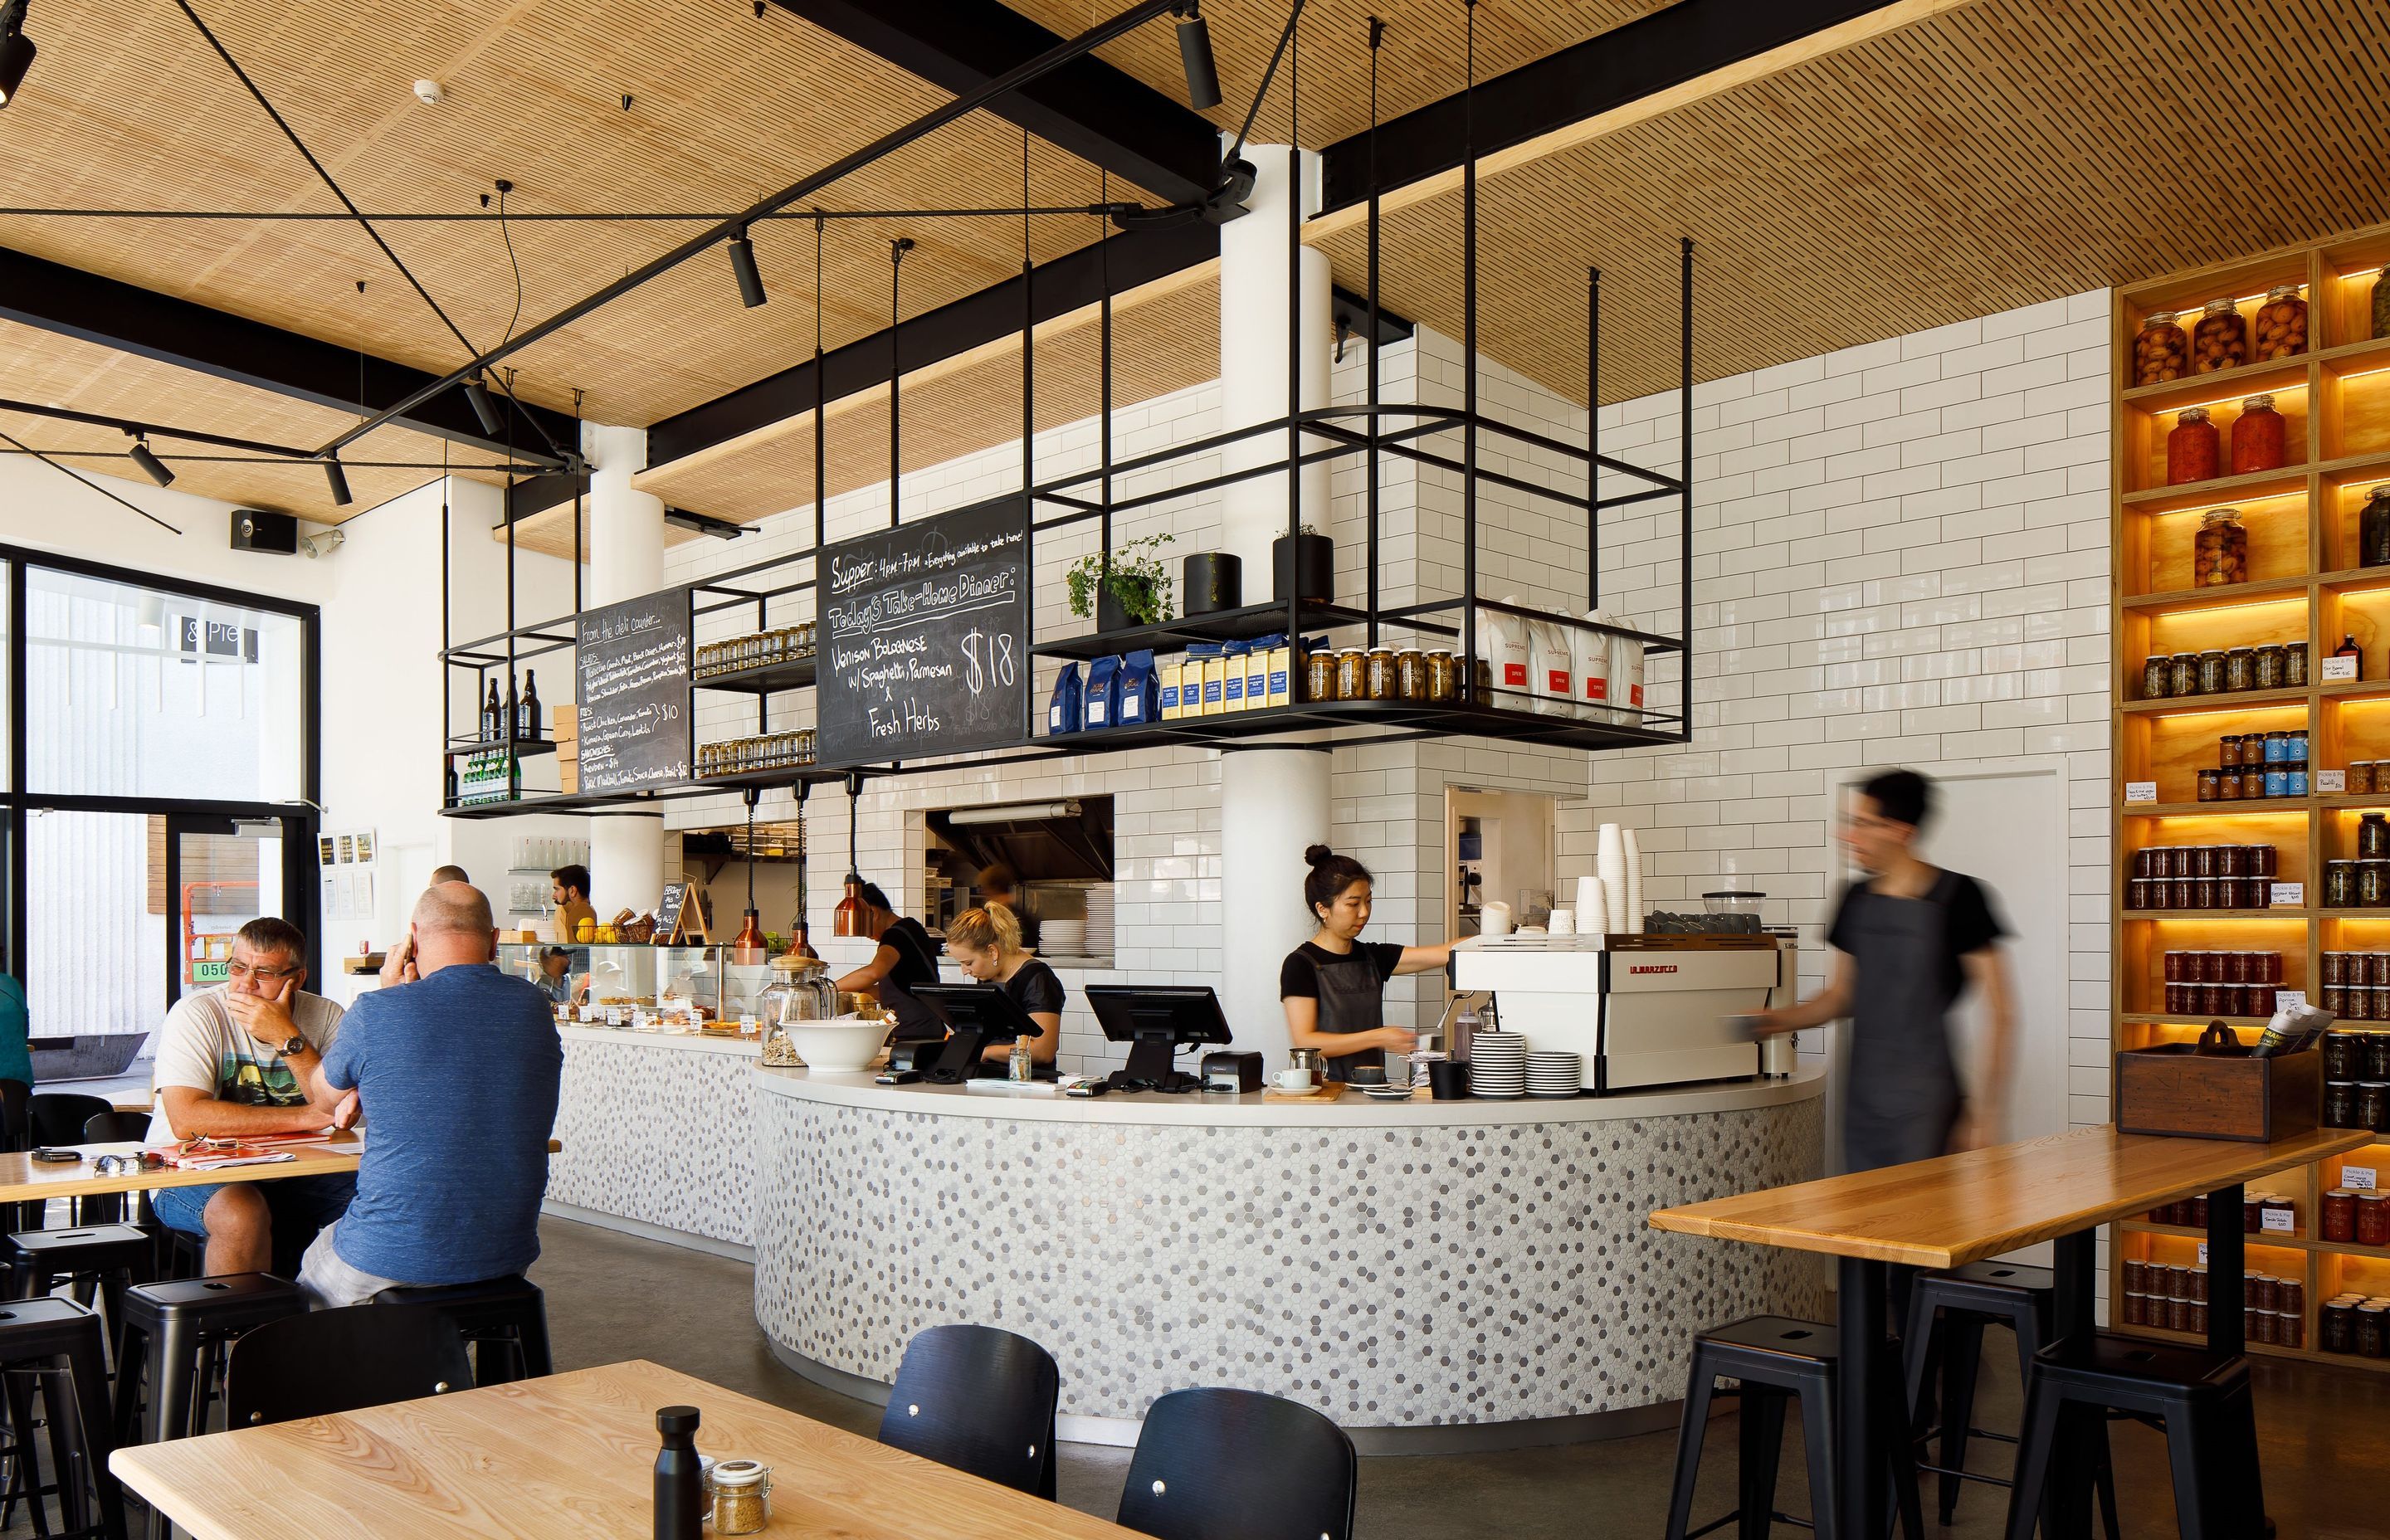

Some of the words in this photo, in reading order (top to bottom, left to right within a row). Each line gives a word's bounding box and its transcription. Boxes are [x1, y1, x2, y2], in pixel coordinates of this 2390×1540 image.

[832, 555, 878, 592] Supper:
[981, 544, 988, 553] to
[990, 534, 1004, 548] take
[959, 567, 1016, 600] Dinner:
[188, 621, 197, 642] &
[208, 621, 238, 642] Pie
[582, 621, 599, 644] From
[602, 618, 614, 641] the
[615, 615, 629, 636] deli
[861, 662, 910, 689] Spaghetti,
[909, 657, 953, 682] Parmesan
[961, 626, 1014, 699] $18
[661, 703, 679, 721] $10
[868, 708, 900, 738] Fresh
[904, 696, 940, 733] Herbs
[632, 723, 651, 736] Lentils
